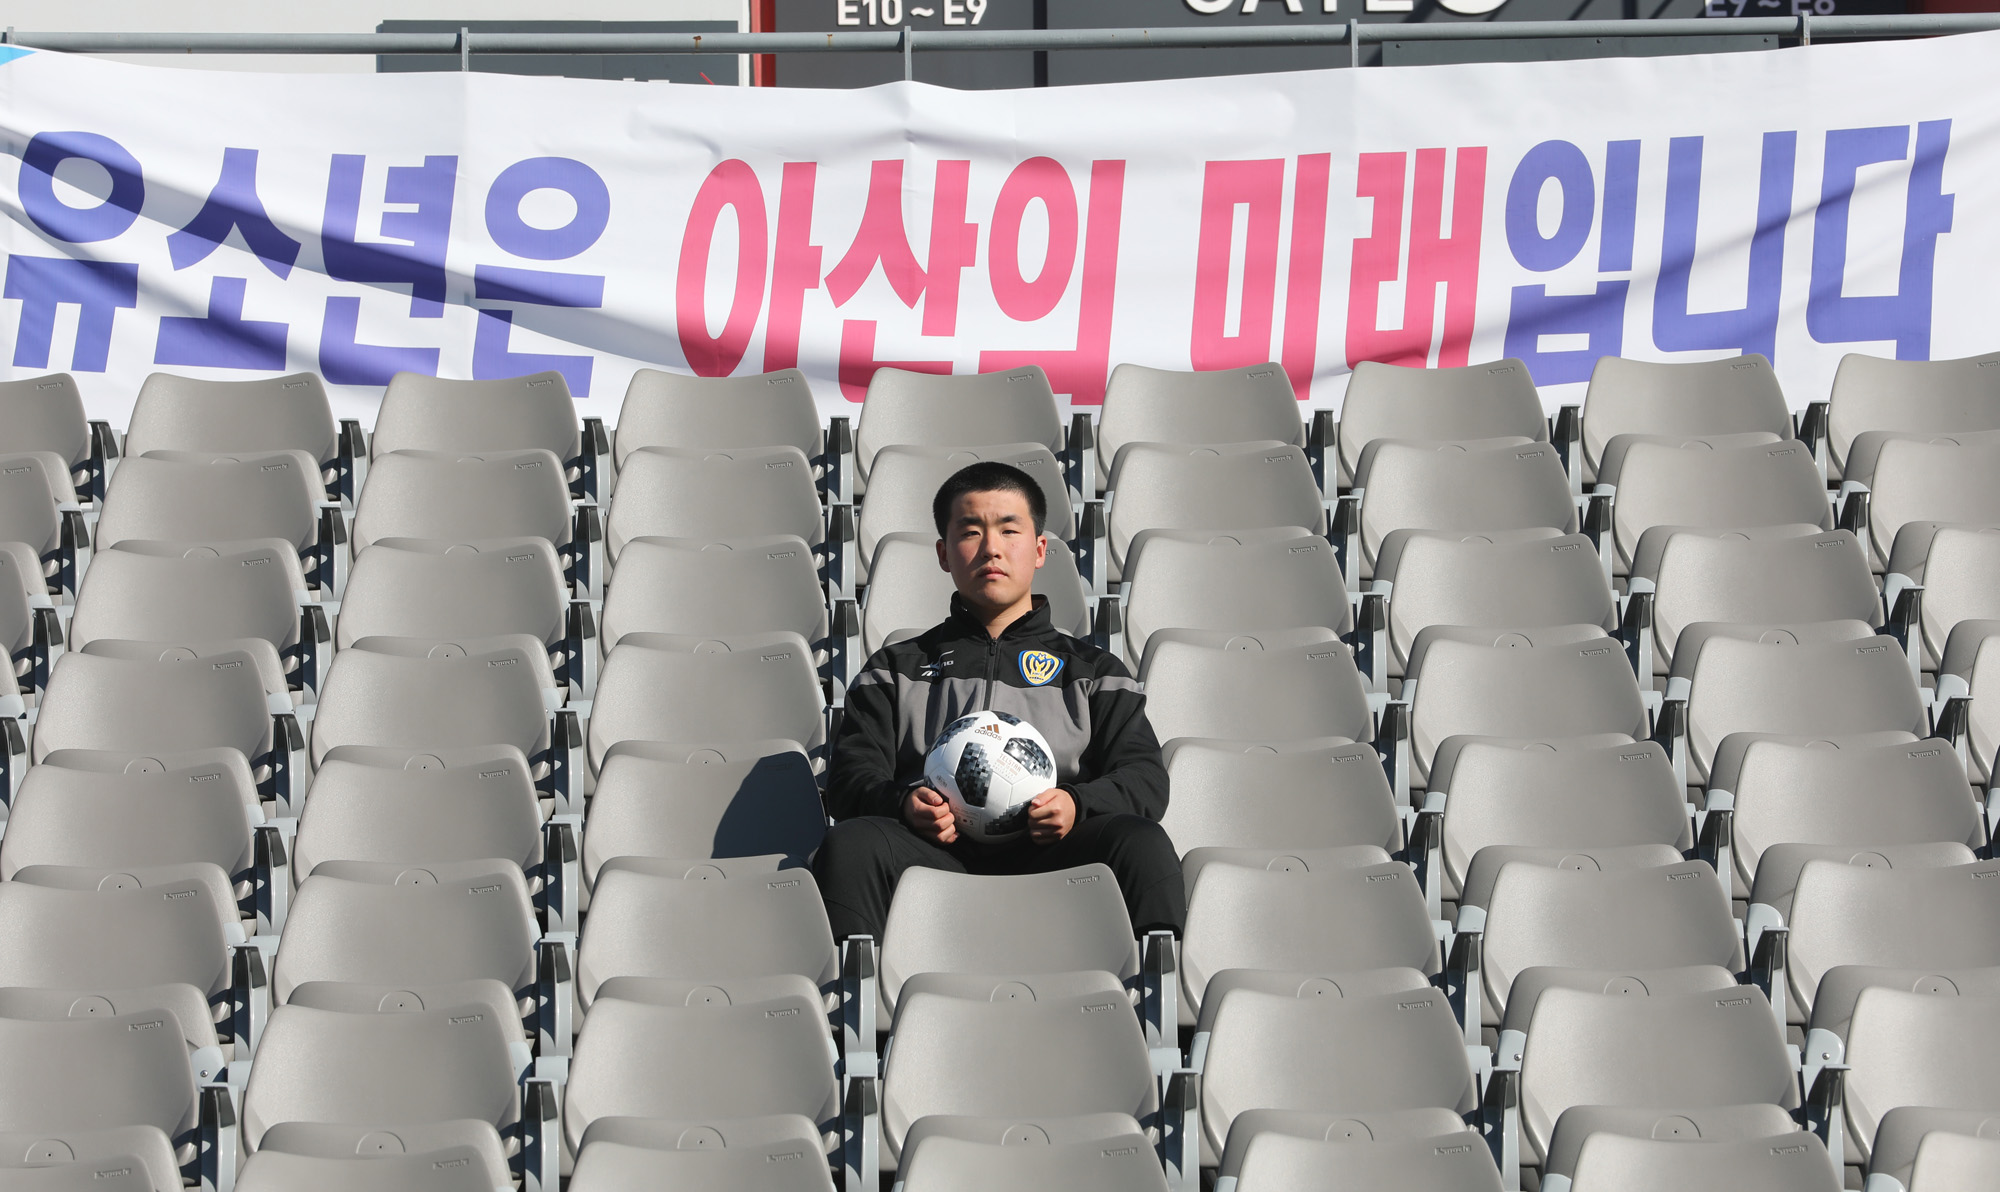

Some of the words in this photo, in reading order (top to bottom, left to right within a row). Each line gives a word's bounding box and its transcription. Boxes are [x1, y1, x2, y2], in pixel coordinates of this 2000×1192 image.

[837, 0, 902, 26] E10
[944, 0, 987, 25] E9
[3, 131, 611, 398] 유소년은
[676, 156, 1127, 406] 아산의
[974, 728, 1003, 741] adidas
